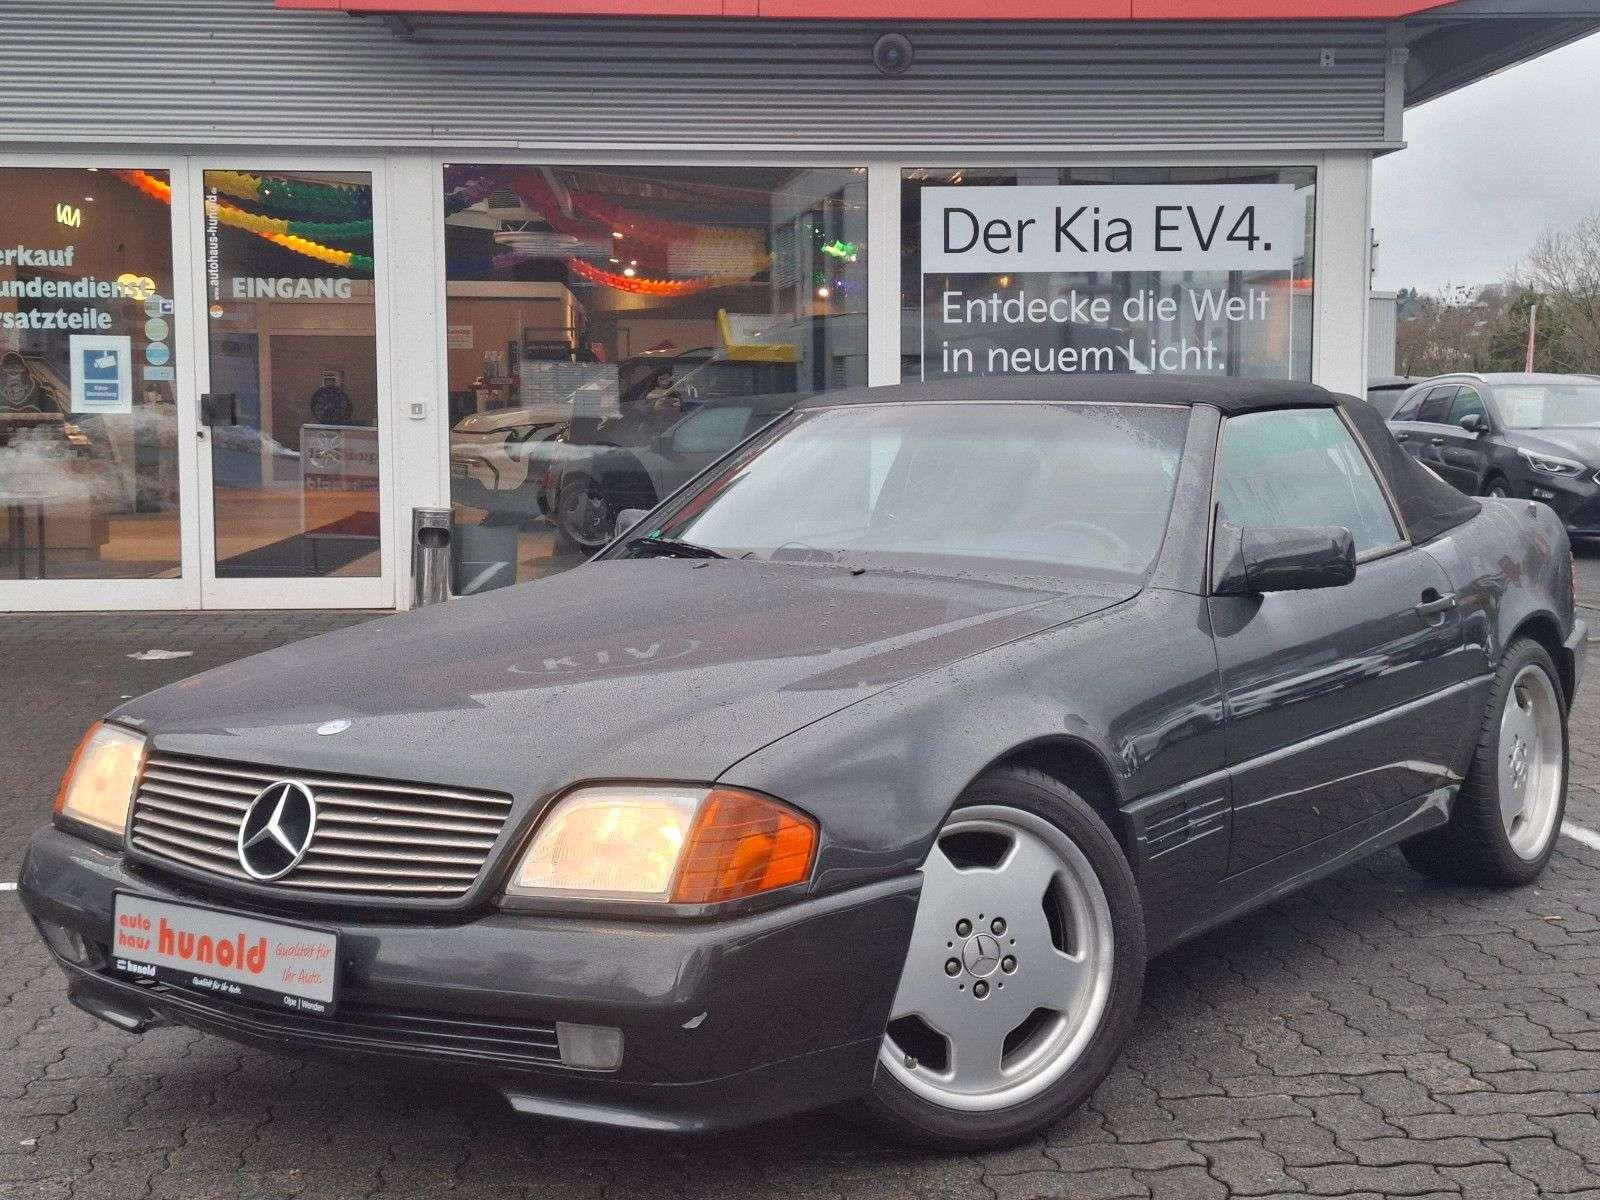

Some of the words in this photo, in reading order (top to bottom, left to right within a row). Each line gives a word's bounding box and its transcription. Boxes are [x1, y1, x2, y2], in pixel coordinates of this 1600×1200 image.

[943, 207, 1036, 254] Der
[1055, 205, 1133, 253] Kia
[1154, 205, 1272, 252] EV4.
[232, 277, 352, 299] EINGANG
[0, 308, 113, 330] satzteile
[943, 290, 1110, 324] Entdecke
[1123, 290, 1177, 322] die
[1188, 288, 1270, 322] Welt
[943, 341, 973, 373] in
[988, 347, 1114, 373] neuem
[1129, 338, 1226, 371] Licht.
[118, 913, 152, 931] auto
[118, 930, 150, 951] haus
[159, 917, 269, 974] hunold
